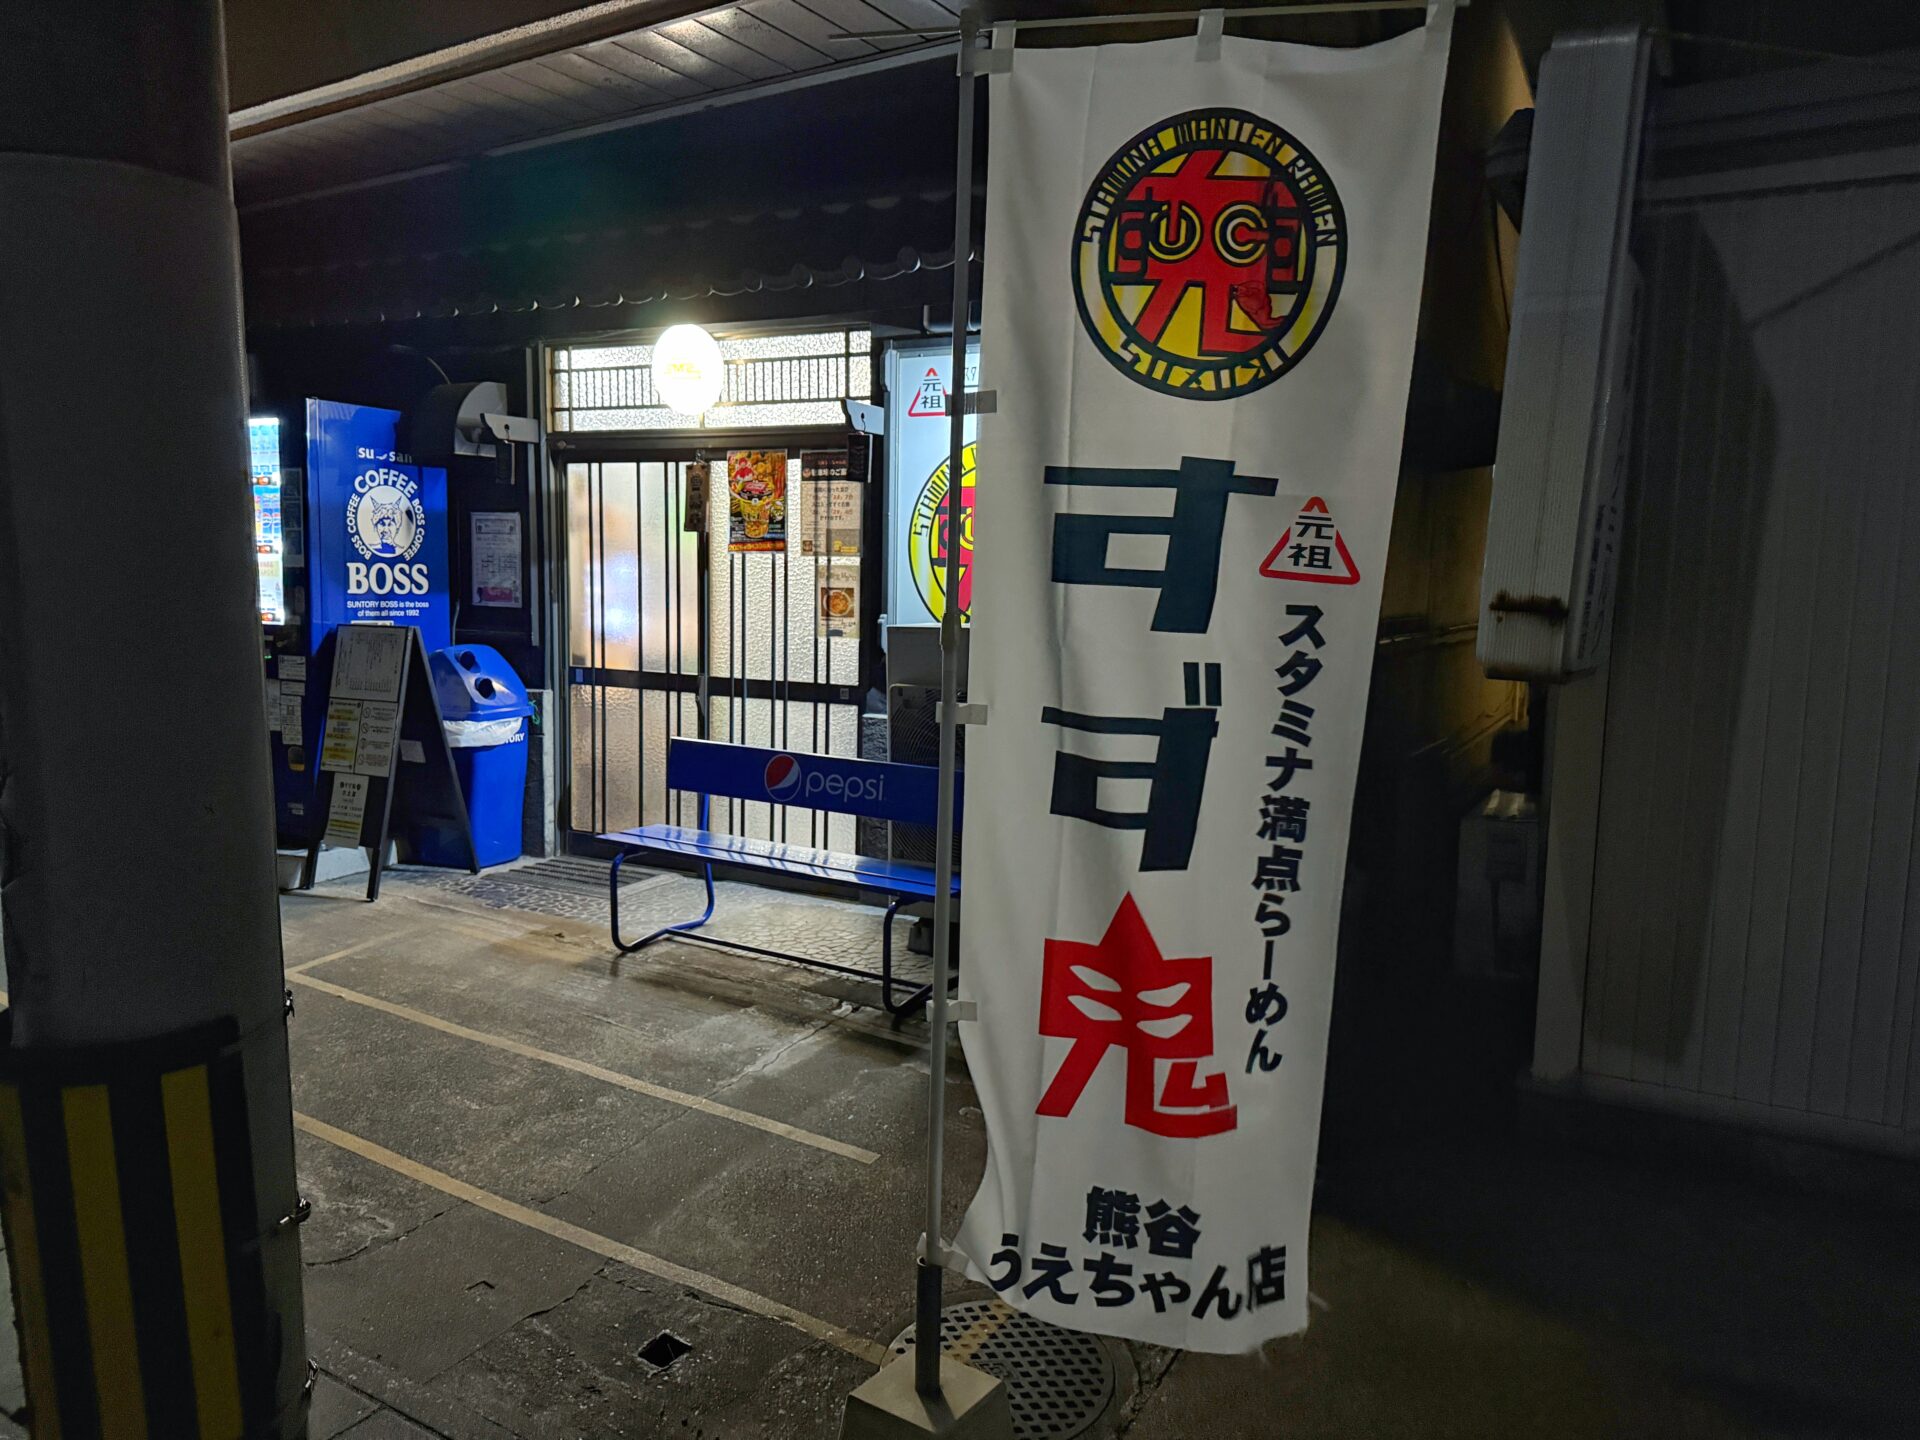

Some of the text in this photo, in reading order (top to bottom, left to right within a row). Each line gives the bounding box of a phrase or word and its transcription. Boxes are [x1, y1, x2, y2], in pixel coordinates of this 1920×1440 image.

[920, 378, 942, 408] 元祖
[354, 468, 418, 499] COFFEE
[346, 493, 373, 561] BOSS COFFEE
[404, 498, 426, 562] BOSS COFFEE
[1287, 514, 1335, 570] 元祖
[346, 562, 430, 595] BOSS
[346, 600, 379, 609] SUNTORY
[357, 609, 365, 617] of
[365, 609, 381, 617] them
[389, 609, 405, 617] since
[805, 771, 885, 803] pepsi
[1244, 604, 1327, 1075] スタミナ満点らーめん
[1082, 1185, 1202, 1260] 熊谷
[990, 1233, 1287, 1321] うえちゃん店
